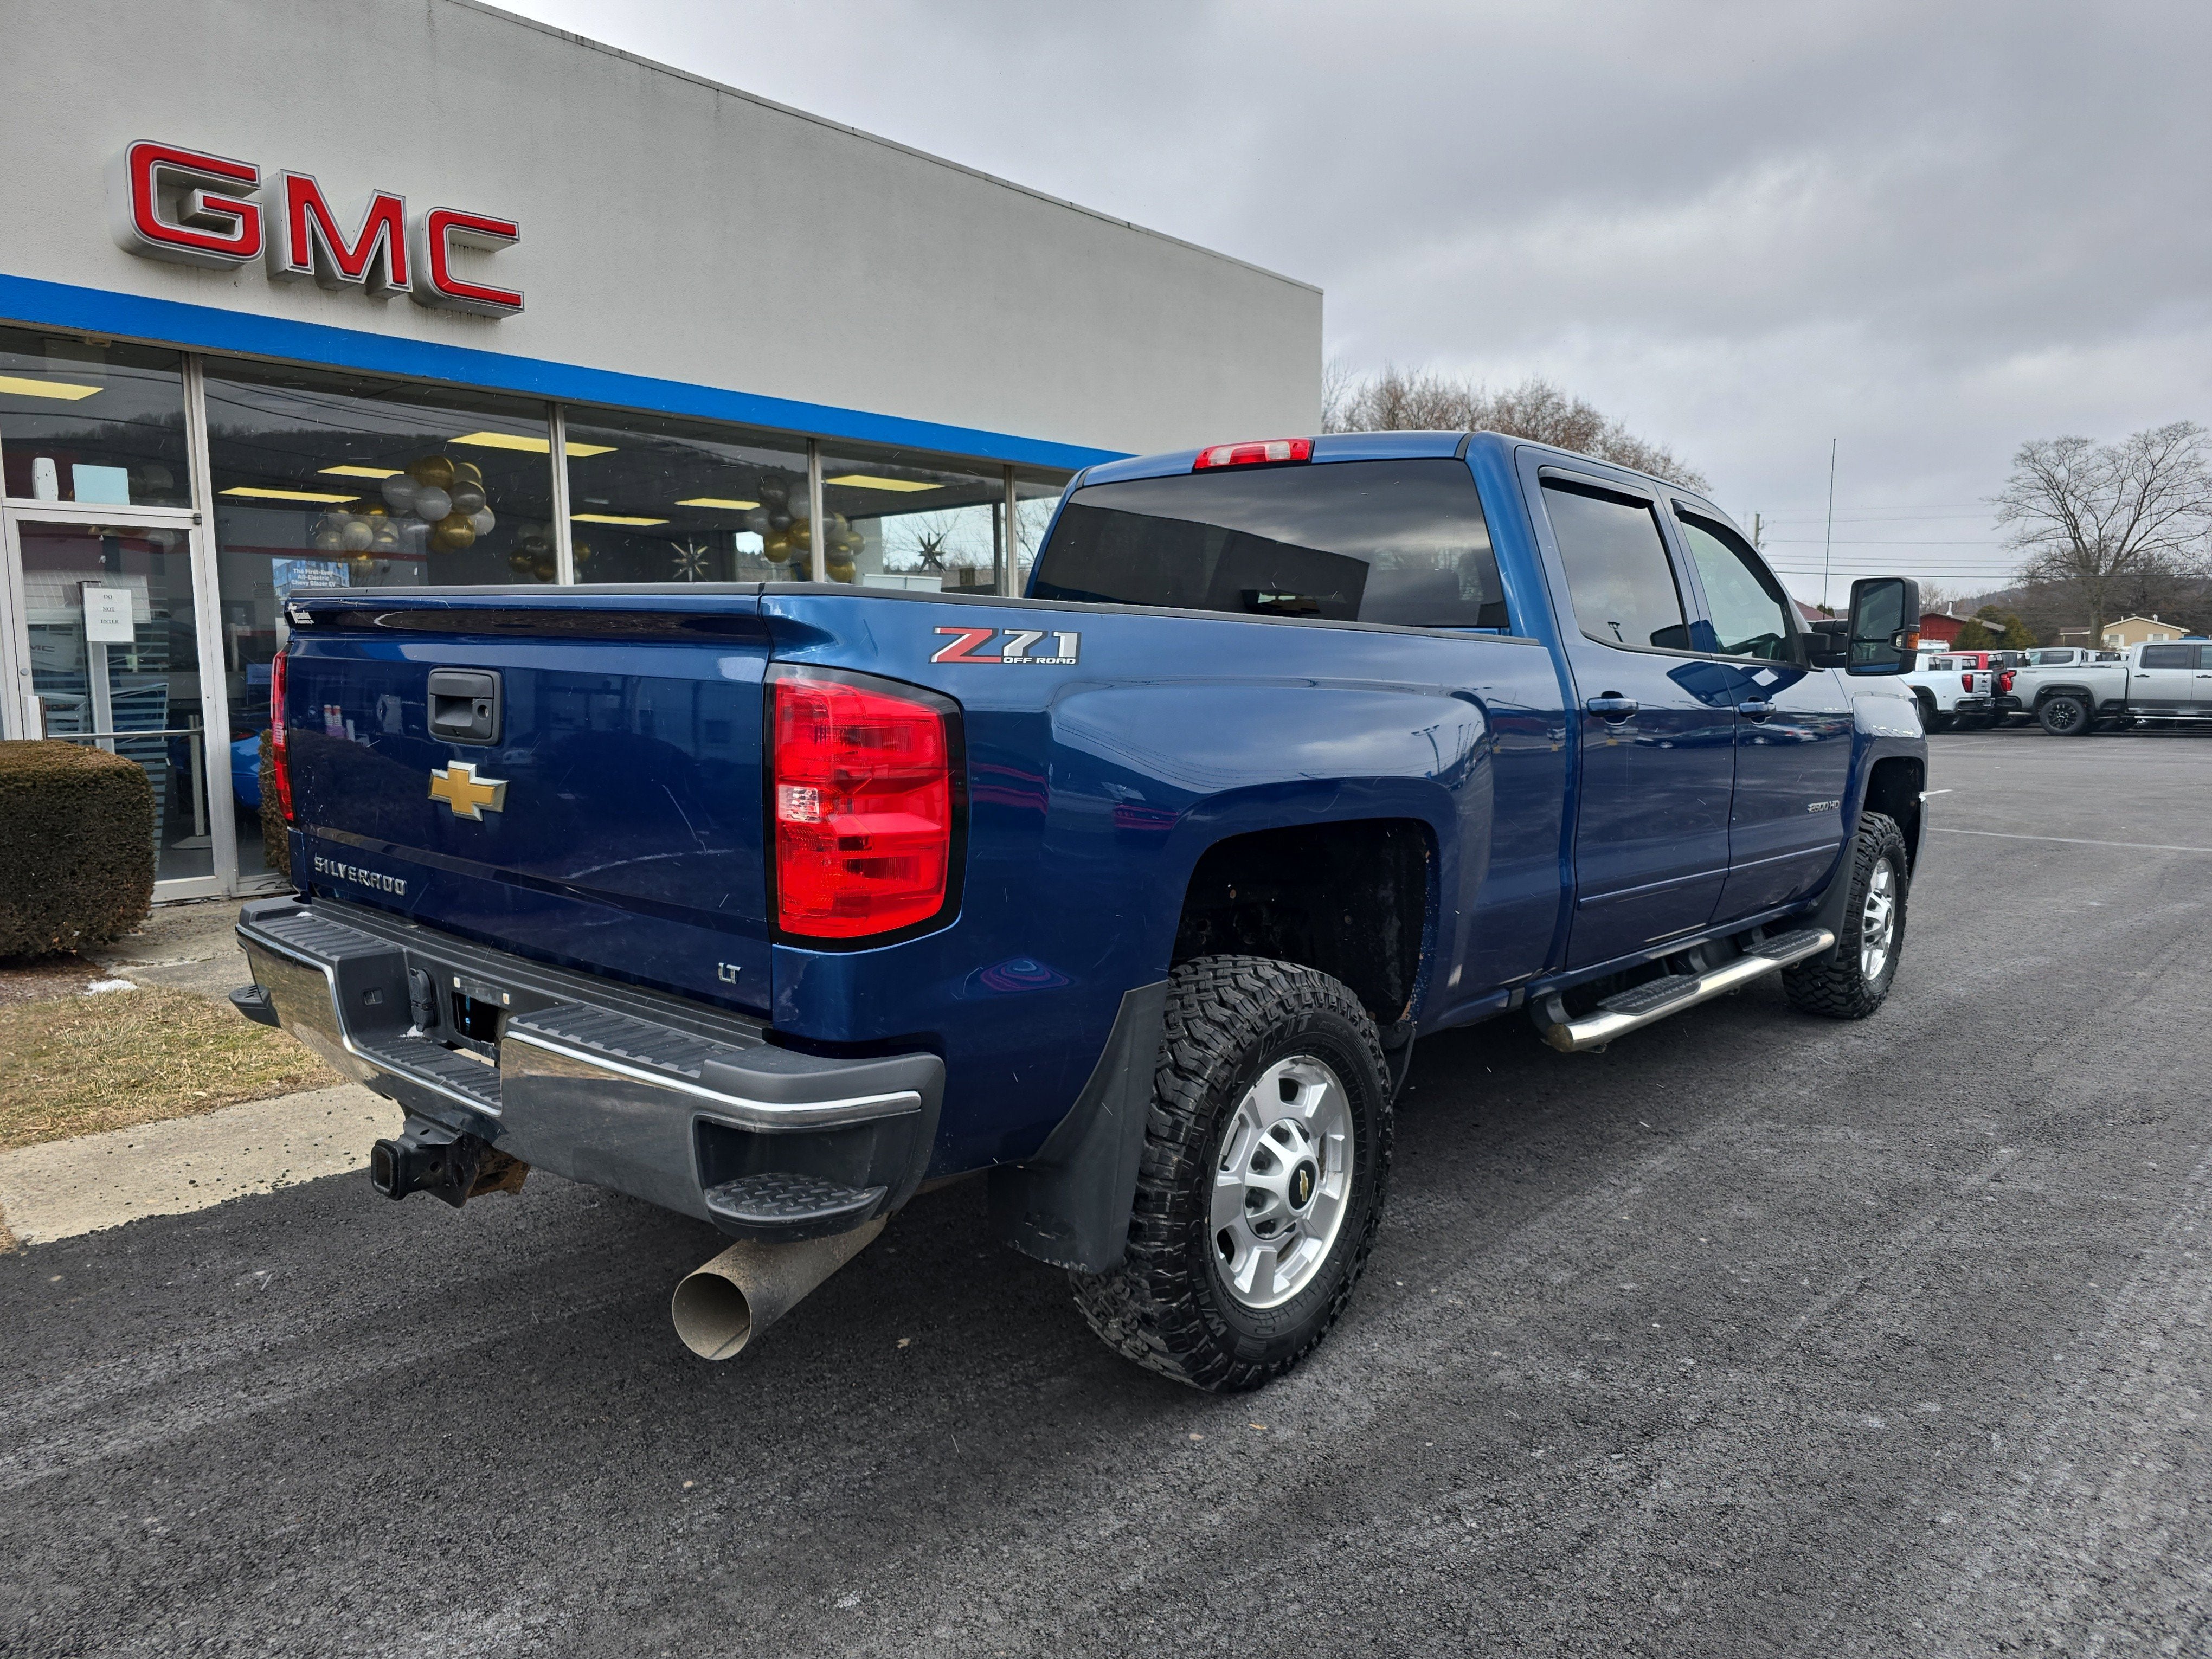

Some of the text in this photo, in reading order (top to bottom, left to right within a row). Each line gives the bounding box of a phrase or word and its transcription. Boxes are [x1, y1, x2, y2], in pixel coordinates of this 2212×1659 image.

[125, 139, 525, 313] GMC
[928, 626, 1082, 663] Z71
[314, 856, 406, 896] SILVERADO
[718, 962, 742, 985] LT
